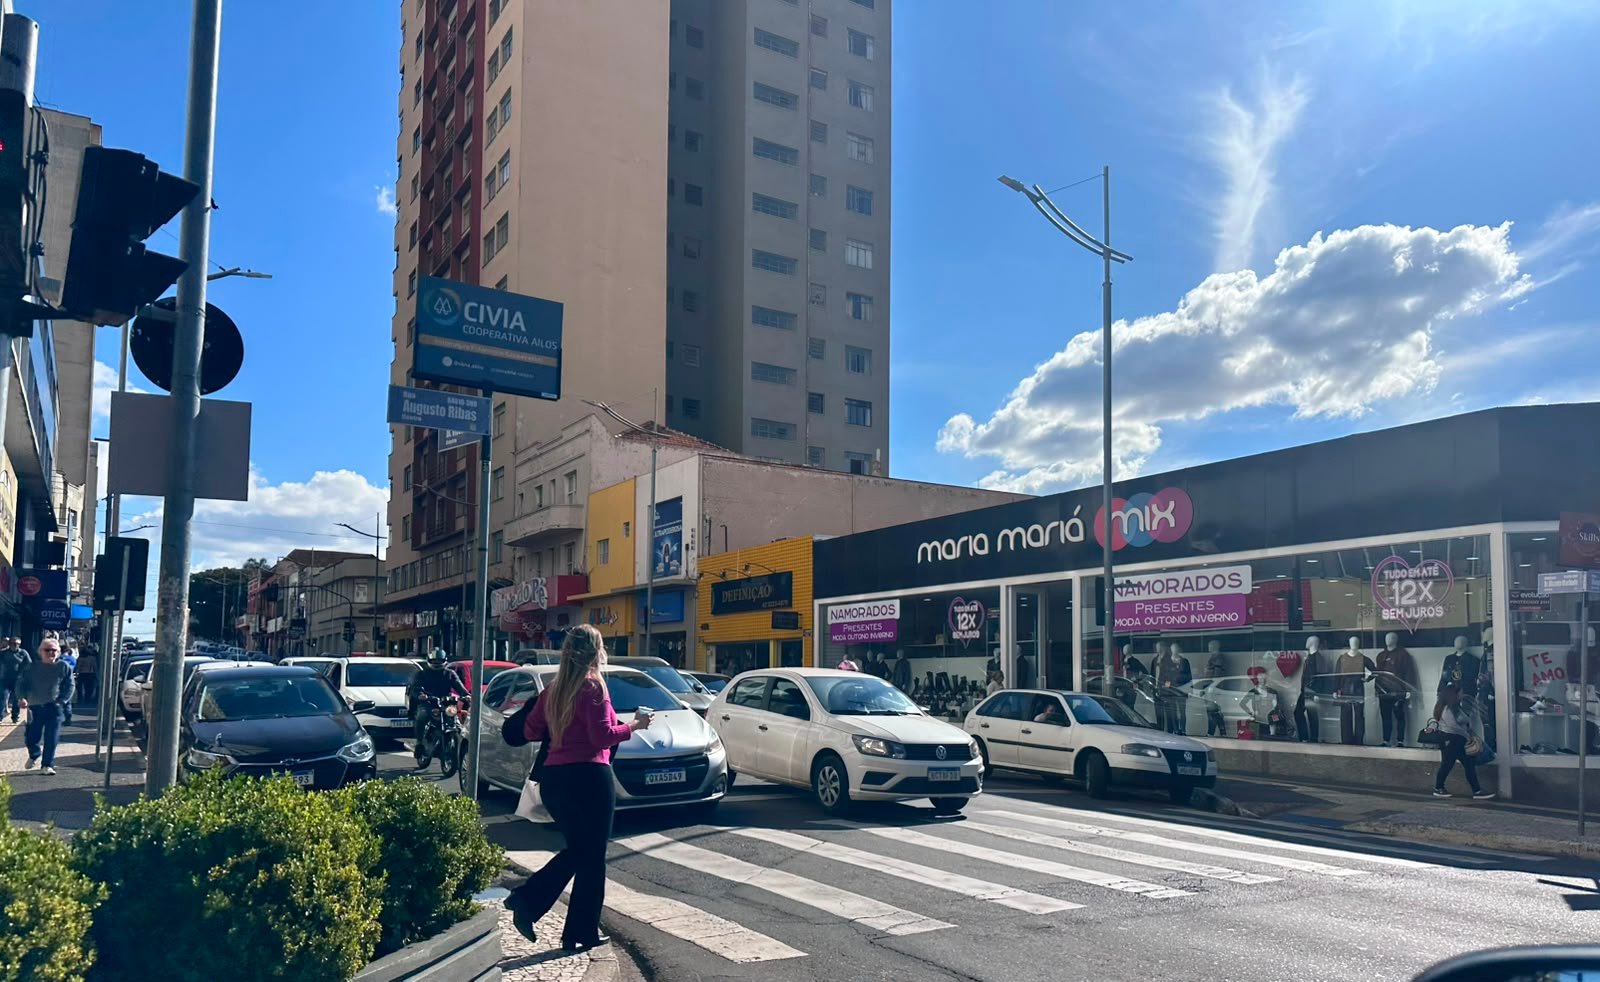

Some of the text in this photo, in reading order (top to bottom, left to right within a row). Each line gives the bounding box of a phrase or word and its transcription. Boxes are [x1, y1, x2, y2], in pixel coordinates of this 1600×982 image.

[463, 301, 527, 332] CIVIA
[462, 324, 529, 345] COOPERATIVA
[531, 337, 559, 351] AILOS
[402, 399, 477, 421] Augusto Ribas
[917, 504, 1085, 564] maria mariá
[1383, 563, 1439, 580] TUDO EM ATÉ
[1113, 572, 1243, 597] NAMORADOS
[1392, 579, 1433, 605] 12X
[830, 604, 896, 620] NAMORADOS
[1135, 600, 1215, 614] PRESENTES
[1382, 606, 1444, 620] SEM JUROS
[842, 622, 883, 633] PRESENTES
[957, 612, 976, 630] 12X
[1114, 612, 1239, 627] MODA OUTONO INVERNO
[847, 633, 869, 641] OUTONO
[870, 631, 894, 640] INVERNO
[1527, 652, 1553, 667] TE
[1532, 667, 1565, 687] AMO
